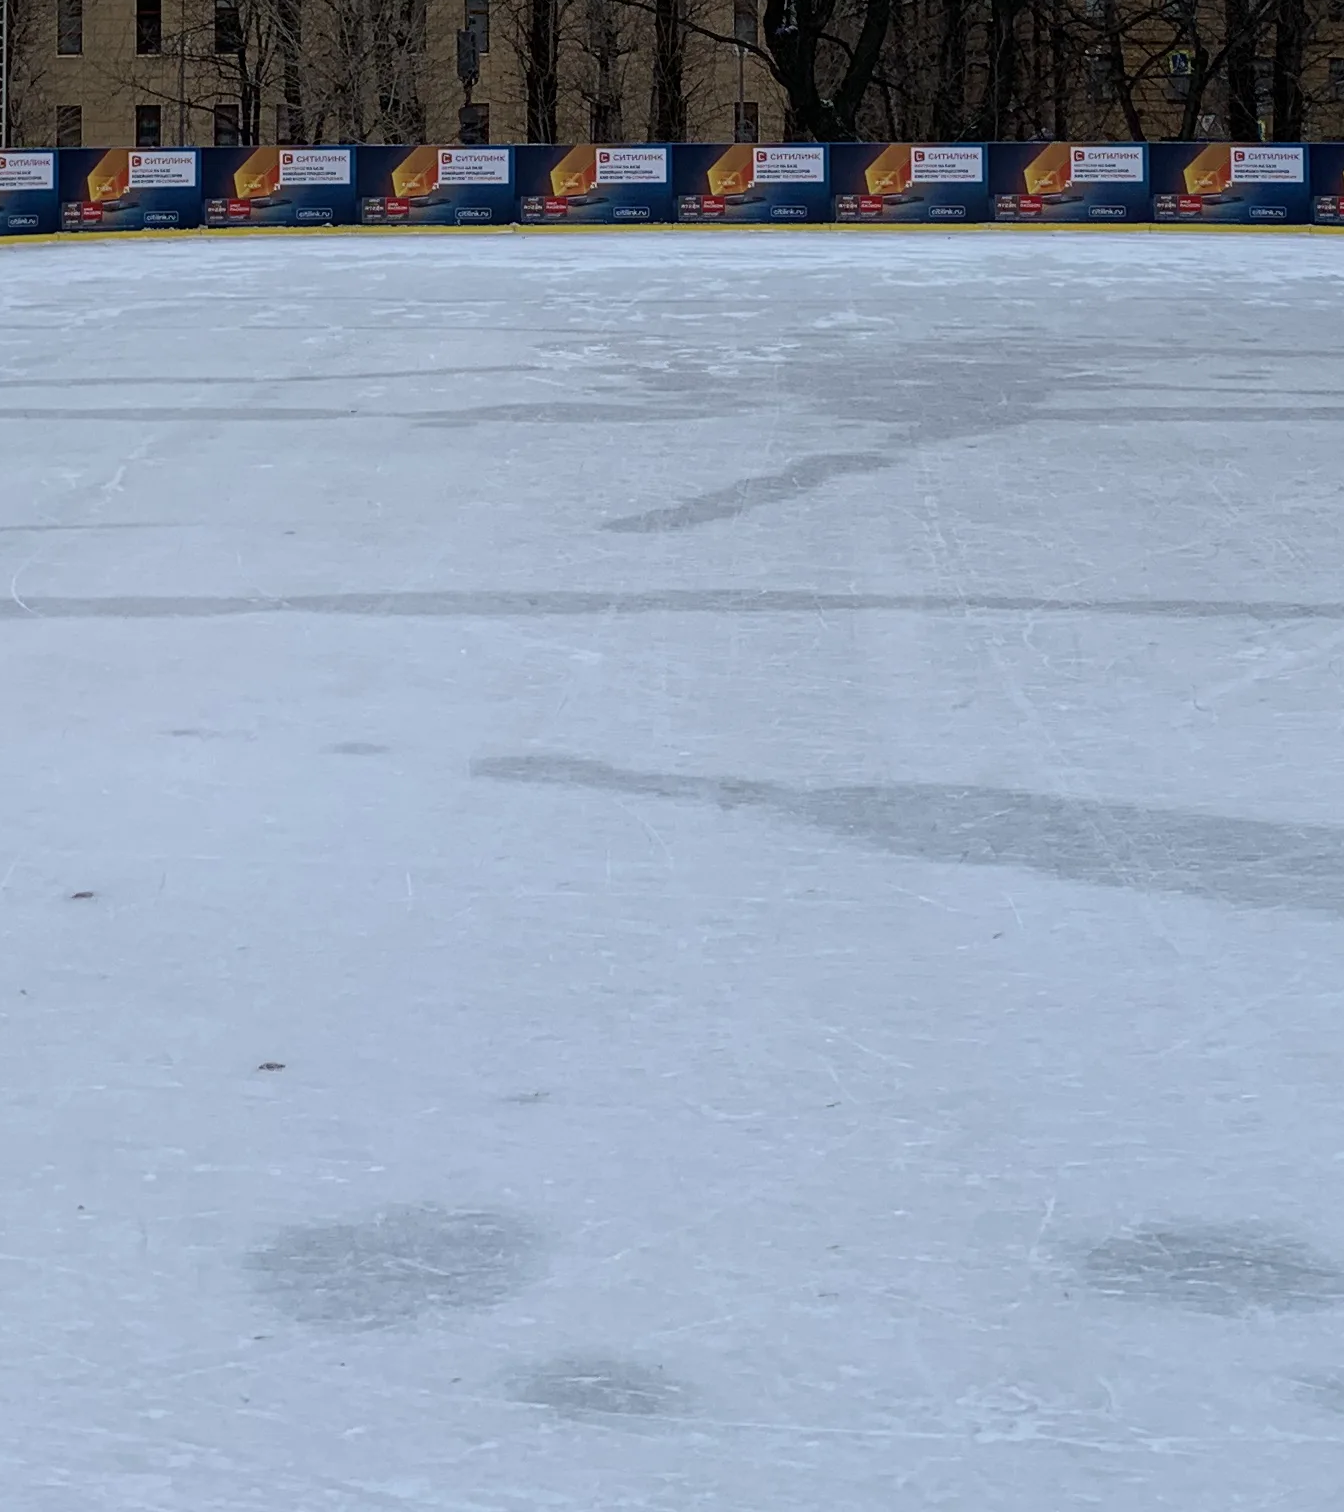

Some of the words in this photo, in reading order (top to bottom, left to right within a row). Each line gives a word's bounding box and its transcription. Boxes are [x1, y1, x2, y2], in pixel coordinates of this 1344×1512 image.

[296, 155, 347, 163] СИТИЛИНК
[770, 153, 820, 161] СИТИЛИНК
[1088, 152, 1139, 160] СИТИЛИНК
[144, 157, 192, 165] СИТИЛИНК
